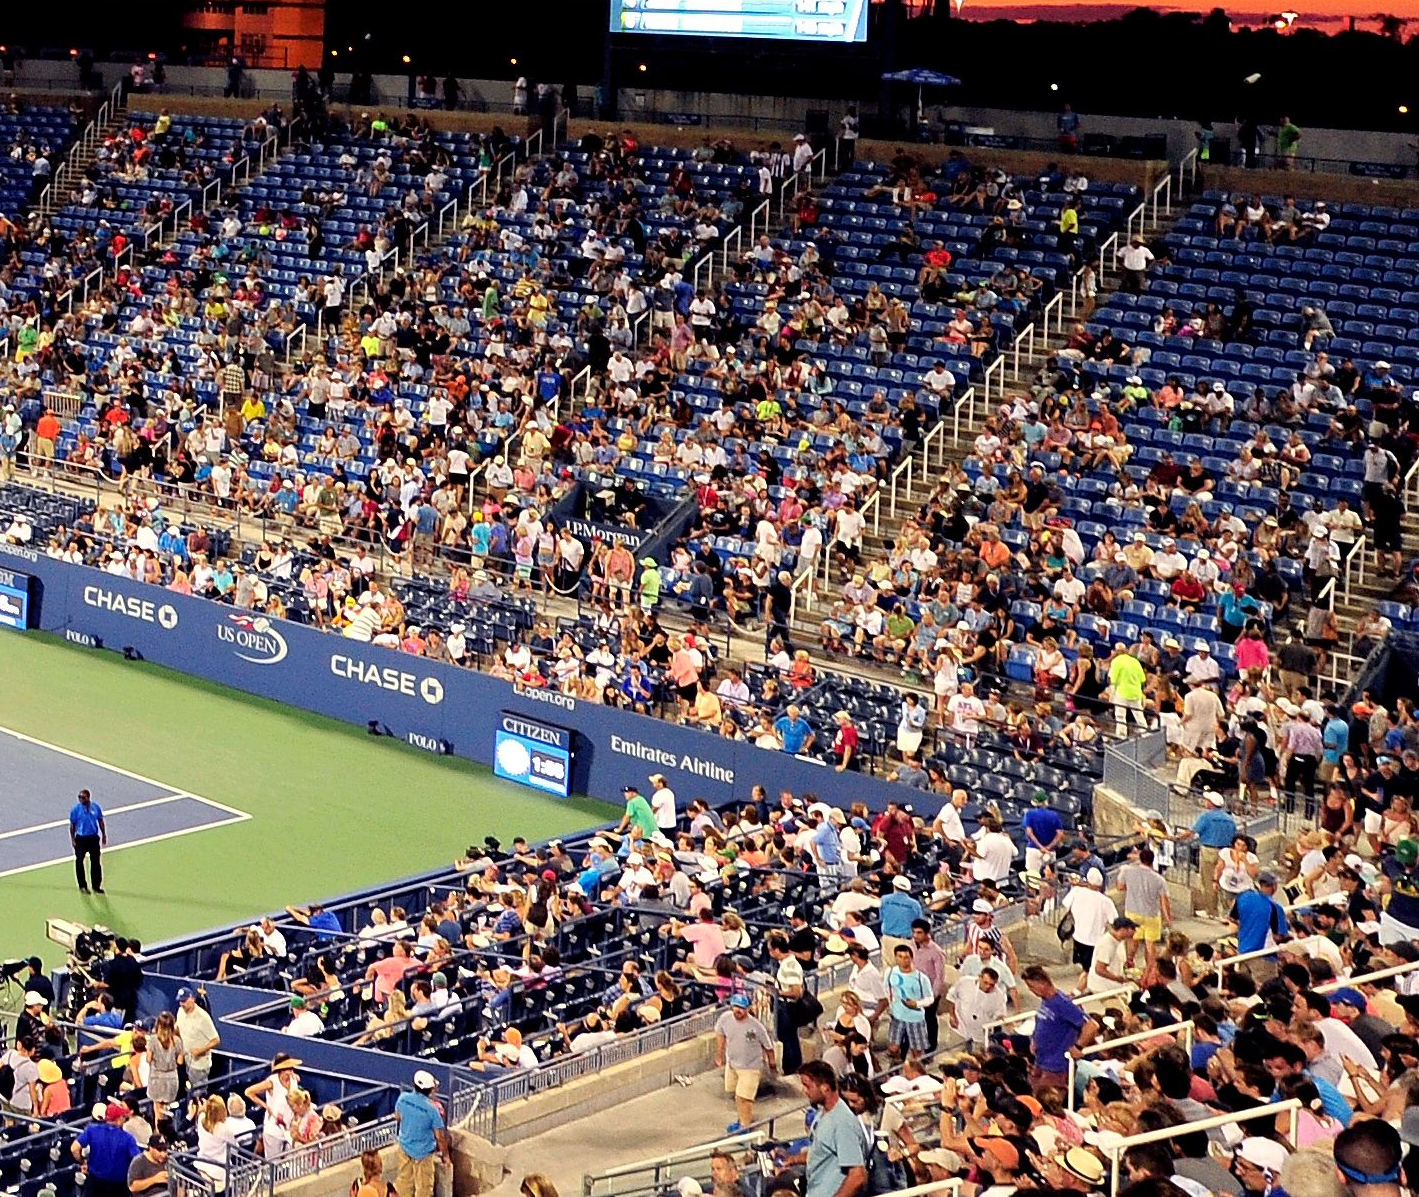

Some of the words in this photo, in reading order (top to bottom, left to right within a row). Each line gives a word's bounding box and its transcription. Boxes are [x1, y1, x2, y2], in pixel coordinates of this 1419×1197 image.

[84, 585, 156, 622] CHASE
[66, 629, 90, 645] POLO
[217, 624, 235, 642] US
[236, 631, 277, 655] OPEN
[331, 654, 417, 696] CHASE
[513, 683, 575, 711] uopen.org
[408, 731, 437, 751] POLO
[502, 717, 561, 746] CITIZEN
[610, 734, 677, 768] Emirates
[679, 754, 735, 783] Airline
